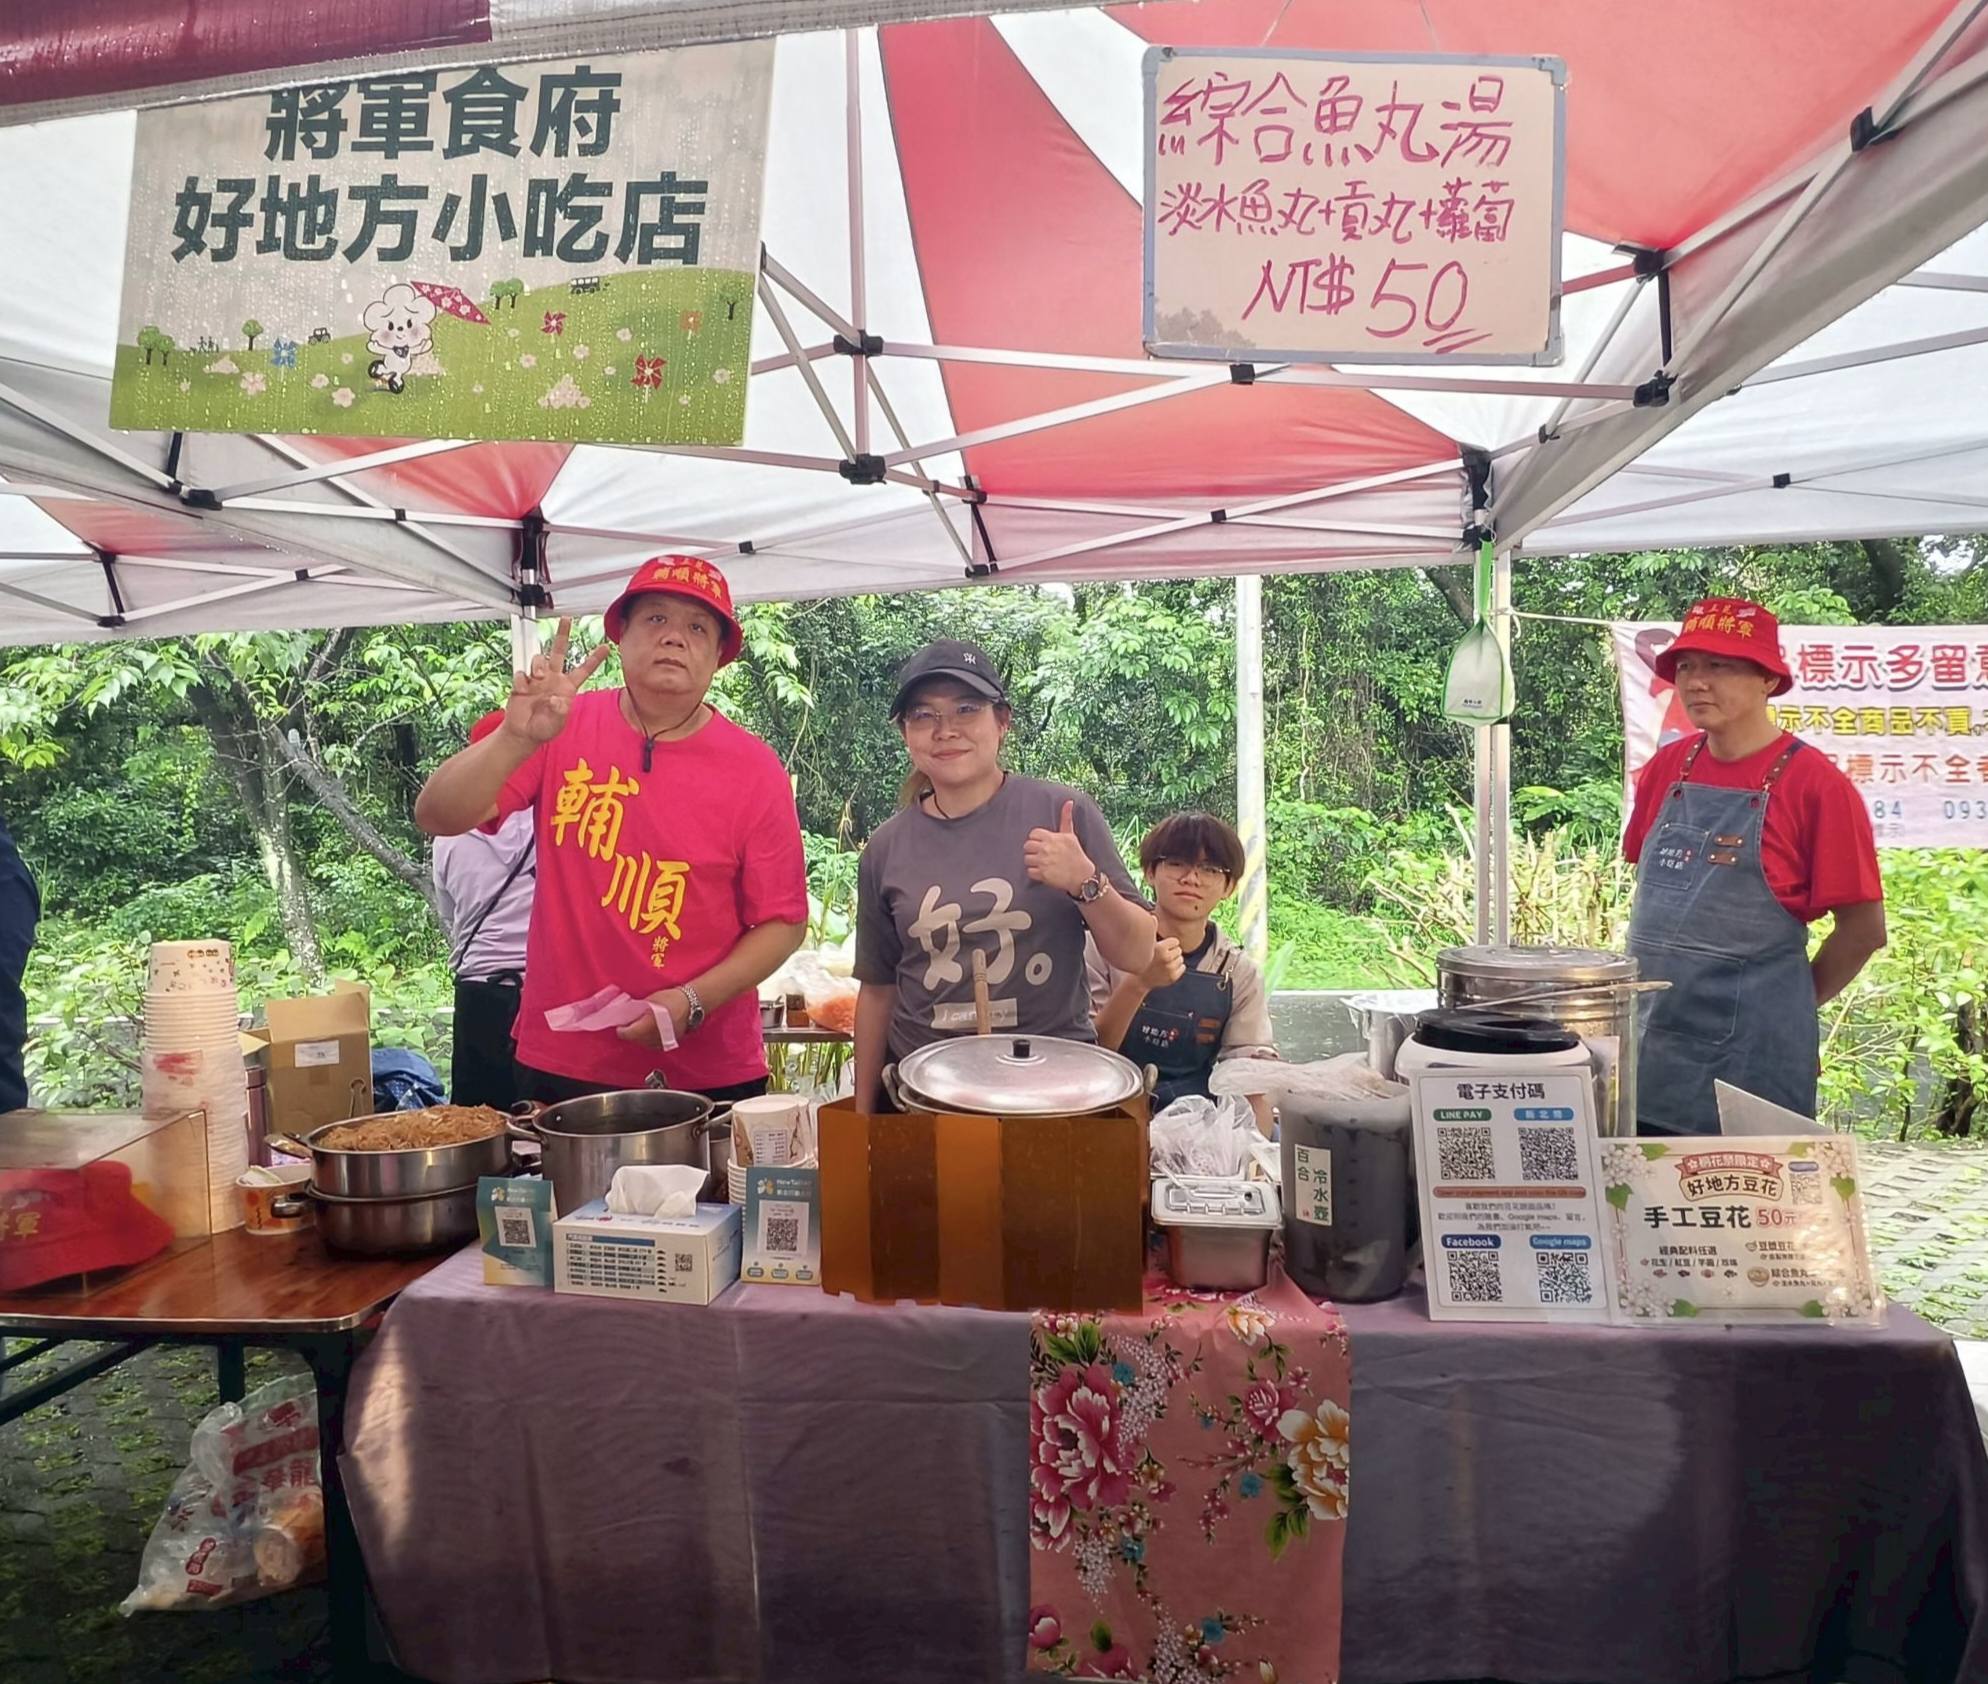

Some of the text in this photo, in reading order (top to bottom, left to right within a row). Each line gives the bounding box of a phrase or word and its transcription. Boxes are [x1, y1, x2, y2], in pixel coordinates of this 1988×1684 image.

[264, 64, 623, 162] 將軍食府
[1158, 71, 1514, 168] 綜合魚丸湯
[170, 170, 709, 266] 好地方小吃店
[1456, 1082, 1546, 1101] 電子支付碼
[1440, 1109, 1484, 1120] LINE PAY
[1296, 1146, 1310, 1182] 百合
[1686, 1173, 1779, 1198] 好地方豆花
[1643, 1205, 1752, 1230] 手工豆花
[1445, 1236, 1494, 1248] Facebook
